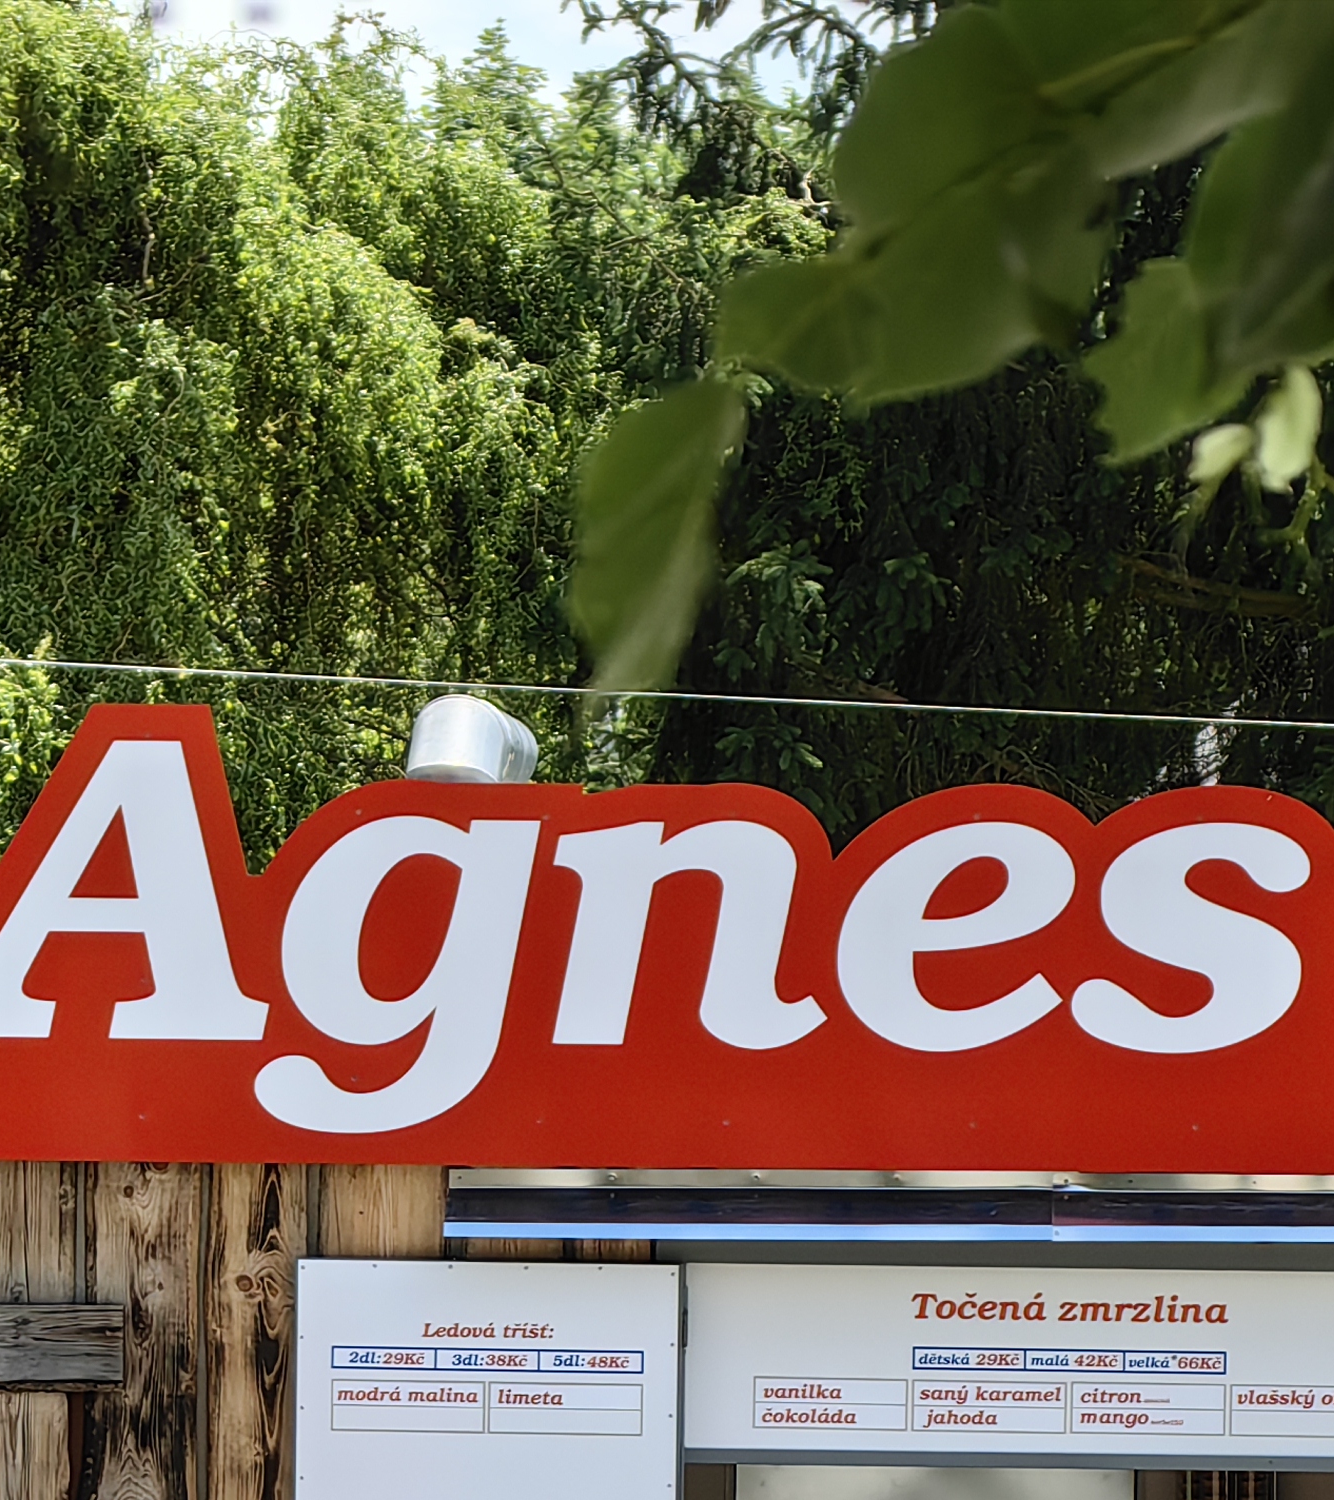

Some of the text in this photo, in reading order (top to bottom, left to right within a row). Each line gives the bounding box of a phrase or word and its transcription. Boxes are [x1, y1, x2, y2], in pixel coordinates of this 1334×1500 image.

[911, 1292, 1229, 1324] Točená zmrzlina
[421, 1323, 496, 1339] Ledová
[918, 1353, 970, 1366] dětská
[975, 1352, 1020, 1367] 29Kč
[1031, 1353, 1070, 1367] malá
[1074, 1353, 1119, 1368] 42Kč
[337, 1386, 479, 1404] modrá malina
[497, 1389, 564, 1406] limeta
[763, 1384, 843, 1400] vanilka
[919, 1385, 1062, 1404] saný karamel
[1080, 1388, 1142, 1404] citron
[1237, 1389, 1316, 1409] vlašský
[761, 1408, 857, 1425] čokoláda
[923, 1410, 998, 1428] jahoda
[1080, 1412, 1150, 1428] mango
